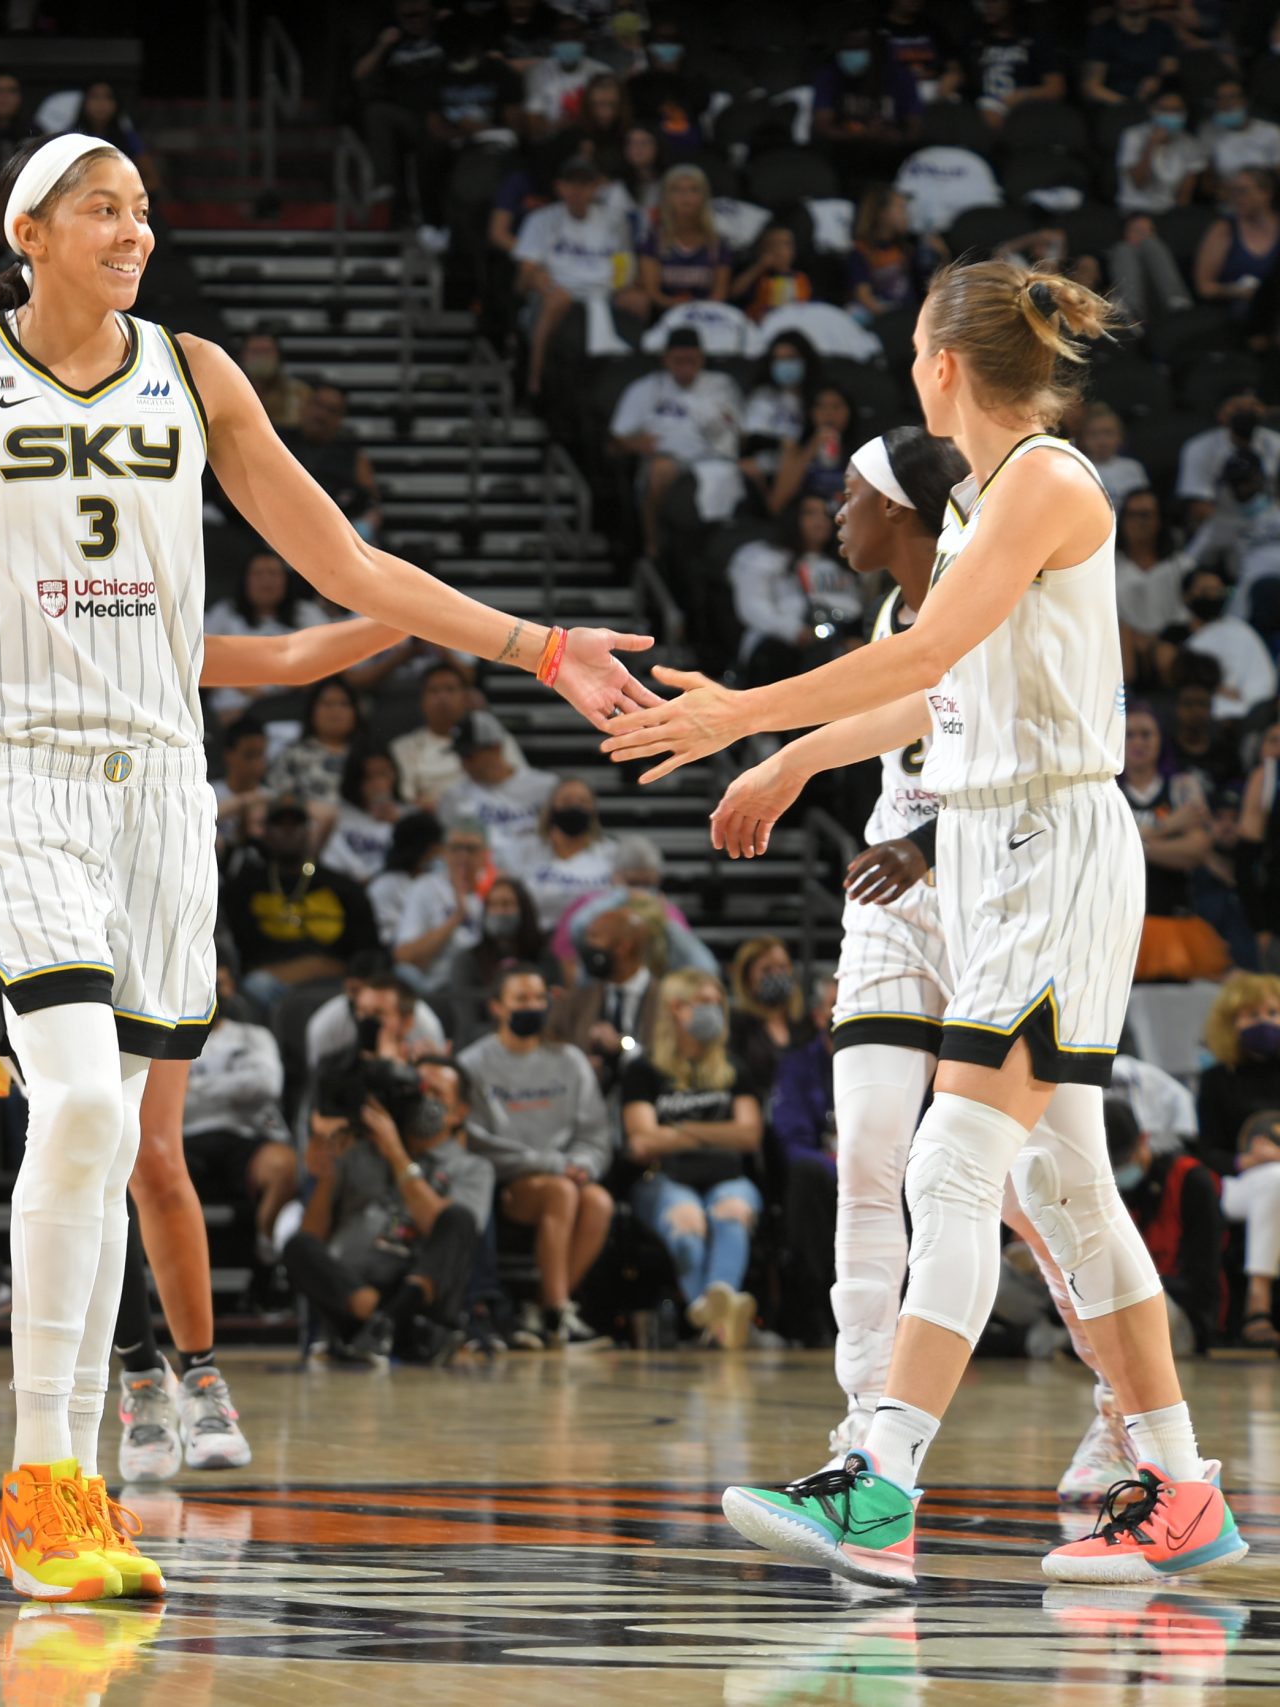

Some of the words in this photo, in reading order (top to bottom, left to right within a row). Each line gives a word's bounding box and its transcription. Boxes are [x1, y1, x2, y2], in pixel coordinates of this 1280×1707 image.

[76, 495, 119, 561] 3
[74, 578, 156, 598] UChicago
[74, 599, 157, 618] Medicine
